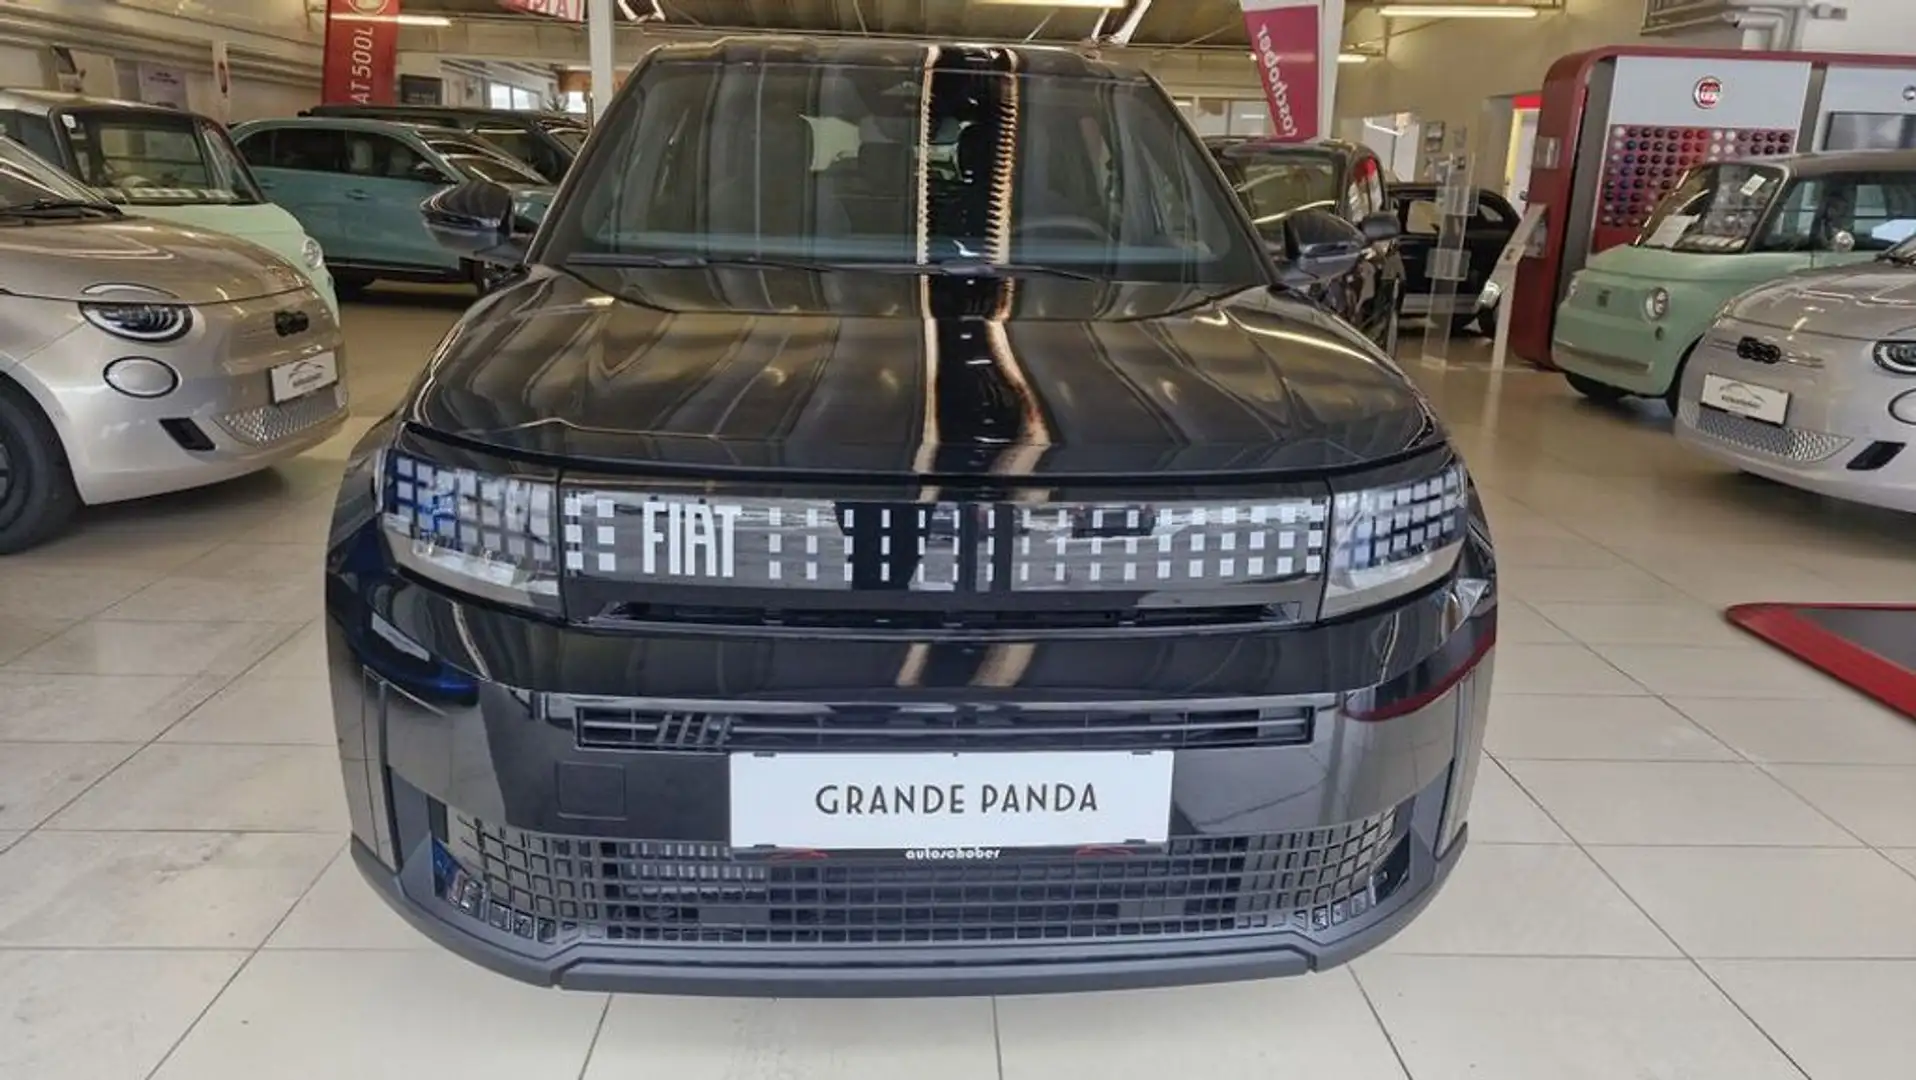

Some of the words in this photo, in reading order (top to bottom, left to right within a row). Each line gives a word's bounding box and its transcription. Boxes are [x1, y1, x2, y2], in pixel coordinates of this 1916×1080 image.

[352, 27, 374, 79] 500L
[642, 501, 742, 578] FIAT
[815, 784, 965, 815] GRANDE
[981, 783, 1098, 812] PANDA
[905, 847, 1001, 860] autoschober
